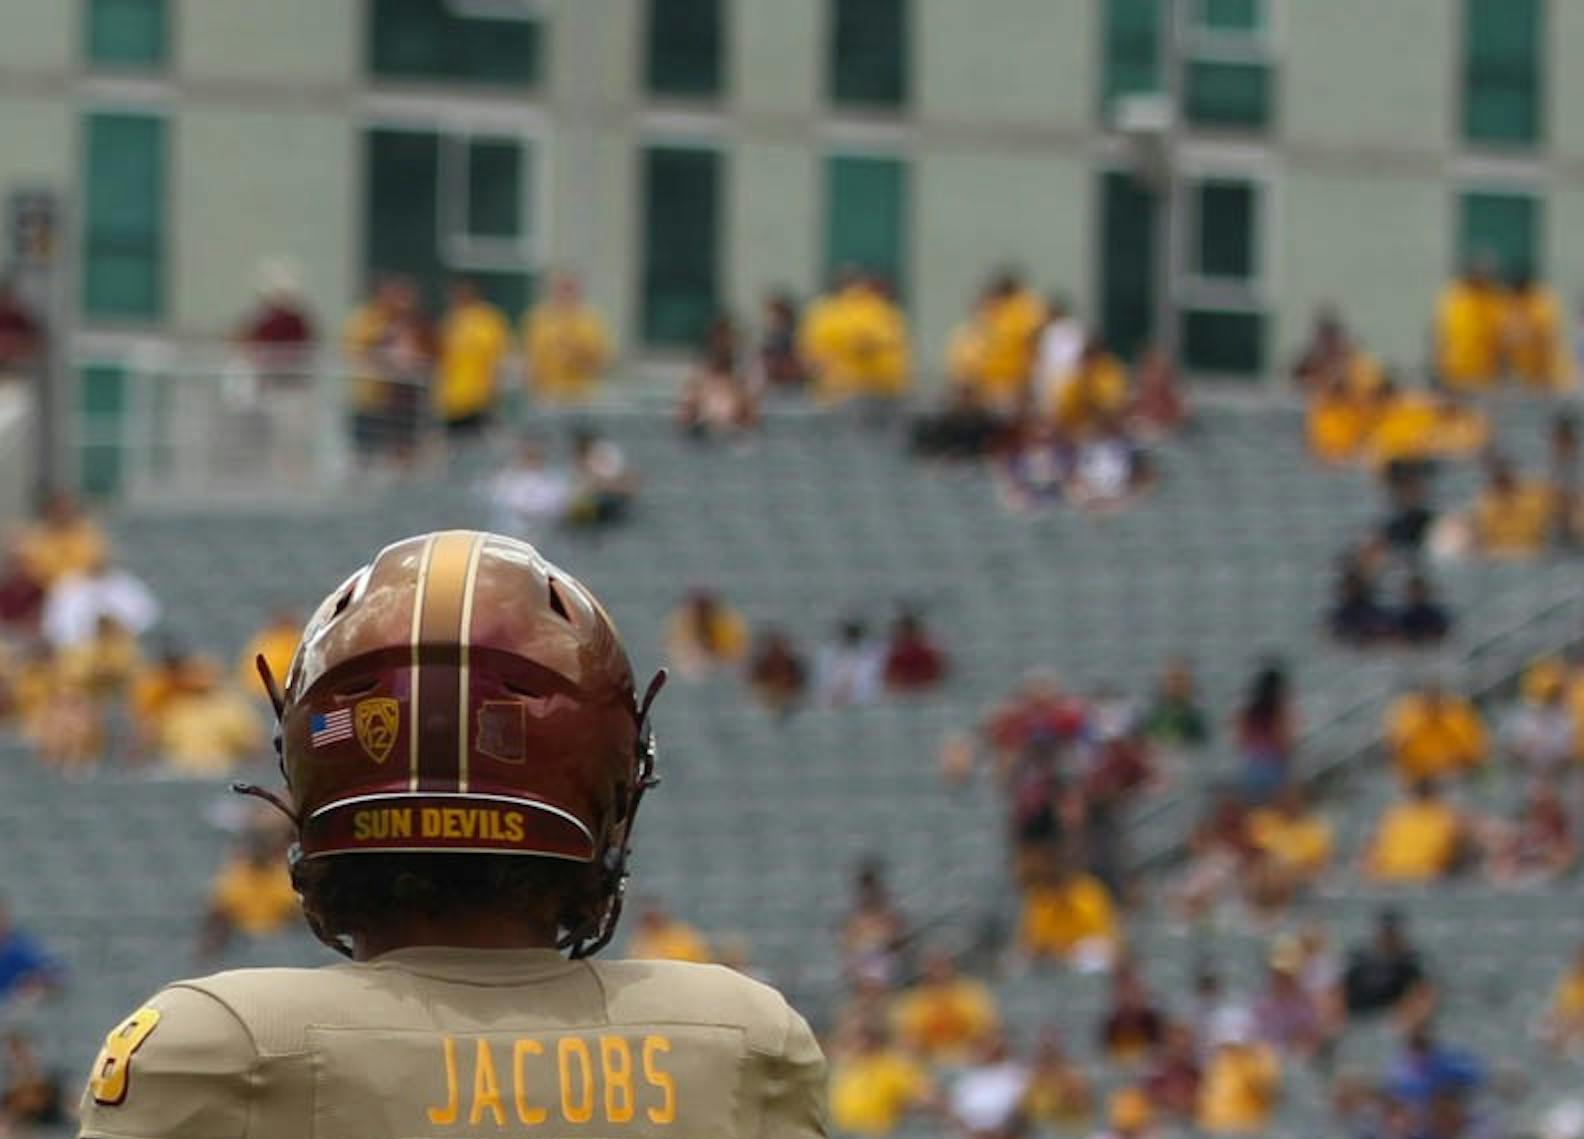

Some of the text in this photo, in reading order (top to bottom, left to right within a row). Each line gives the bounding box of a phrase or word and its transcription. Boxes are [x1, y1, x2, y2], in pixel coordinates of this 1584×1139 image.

[354, 808, 526, 842] SUN DEVILS
[90, 1007, 161, 1106] 8
[426, 1034, 678, 1124] JACOBS
